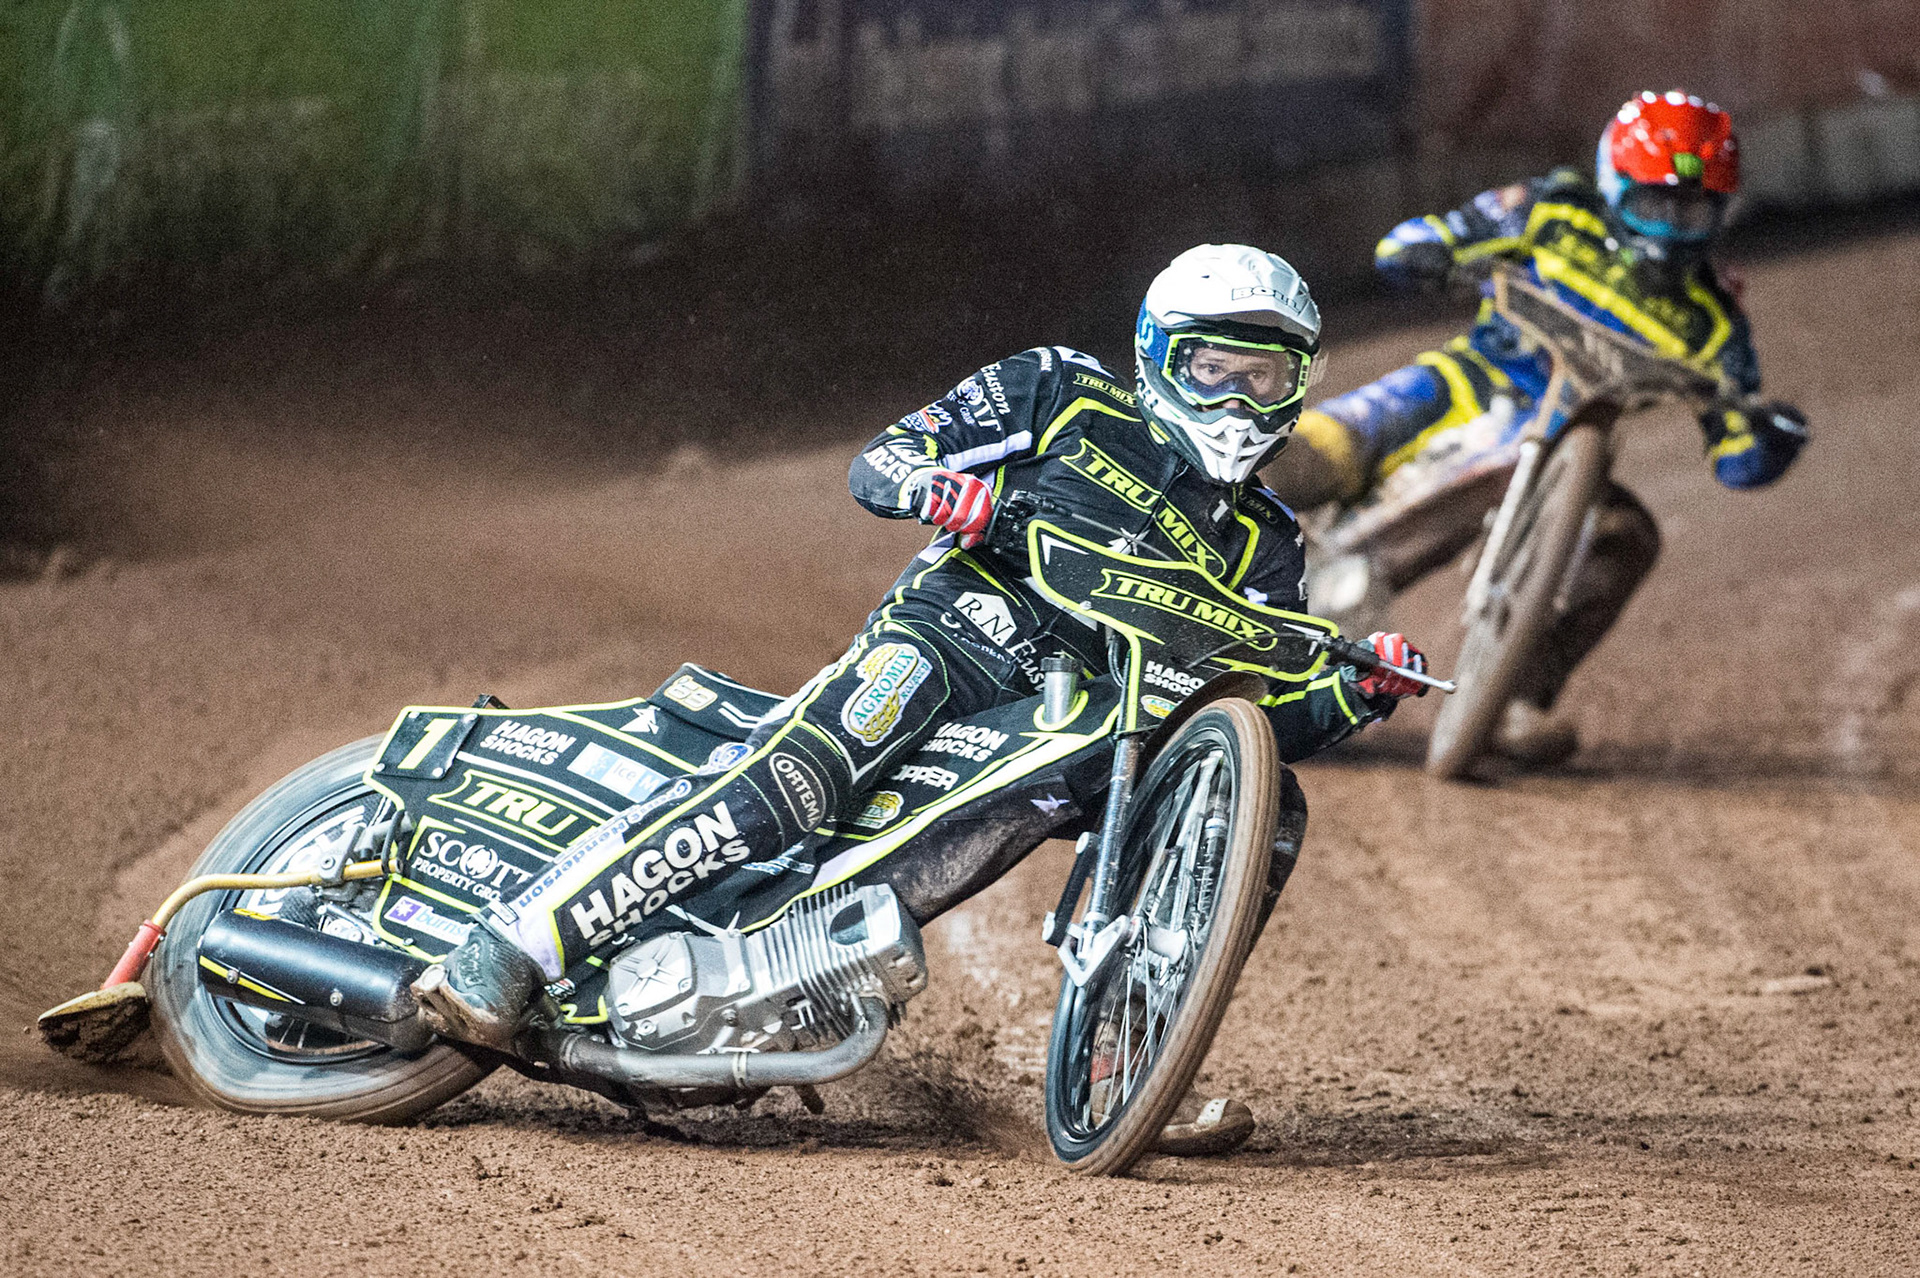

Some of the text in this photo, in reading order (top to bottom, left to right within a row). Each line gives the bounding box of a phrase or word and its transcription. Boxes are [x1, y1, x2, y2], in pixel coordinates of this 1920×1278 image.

[1081, 376, 1135, 405] TRU MIX
[1084, 453, 1217, 573] TRU MIX
[1115, 577, 1267, 640] TRU MIX
[854, 650, 914, 725] AGROMIX
[1143, 673, 1195, 696] SHOC
[1145, 660, 1206, 690] HAGO
[397, 718, 458, 770] 1
[480, 735, 559, 766] SHOCKS
[491, 719, 577, 754] HAGON
[463, 780, 579, 836] TRU
[775, 759, 821, 829] ORTEMA
[411, 856, 502, 902] PROPERTY GRO
[569, 800, 740, 940] HAGON
[588, 839, 751, 948] SHOCKS
